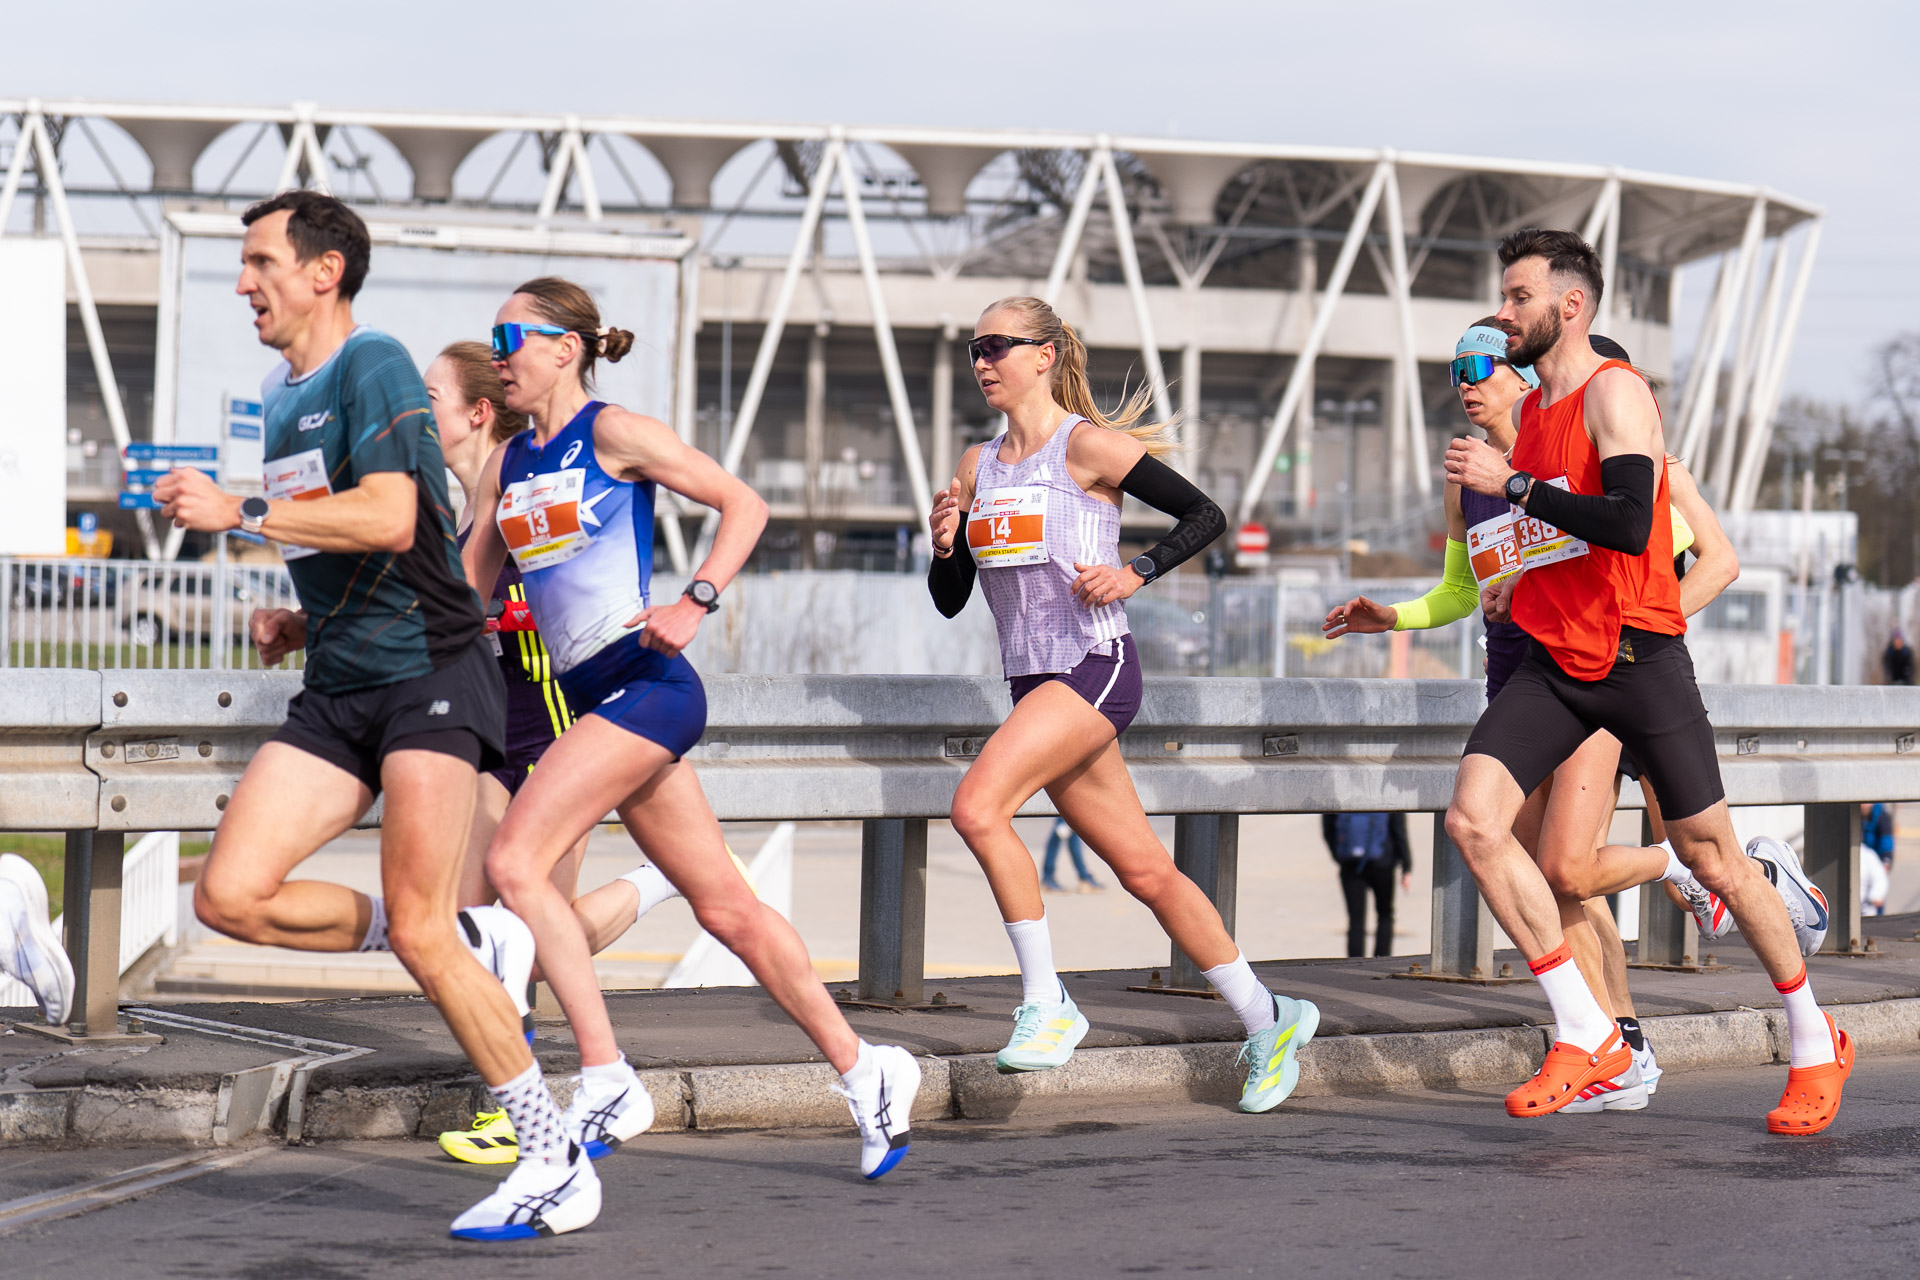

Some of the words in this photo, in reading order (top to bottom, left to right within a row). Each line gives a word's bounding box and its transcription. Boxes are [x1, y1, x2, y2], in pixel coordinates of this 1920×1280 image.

[525, 507, 550, 537] 13
[988, 517, 1011, 539] 14
[1495, 541, 1517, 565] 12
